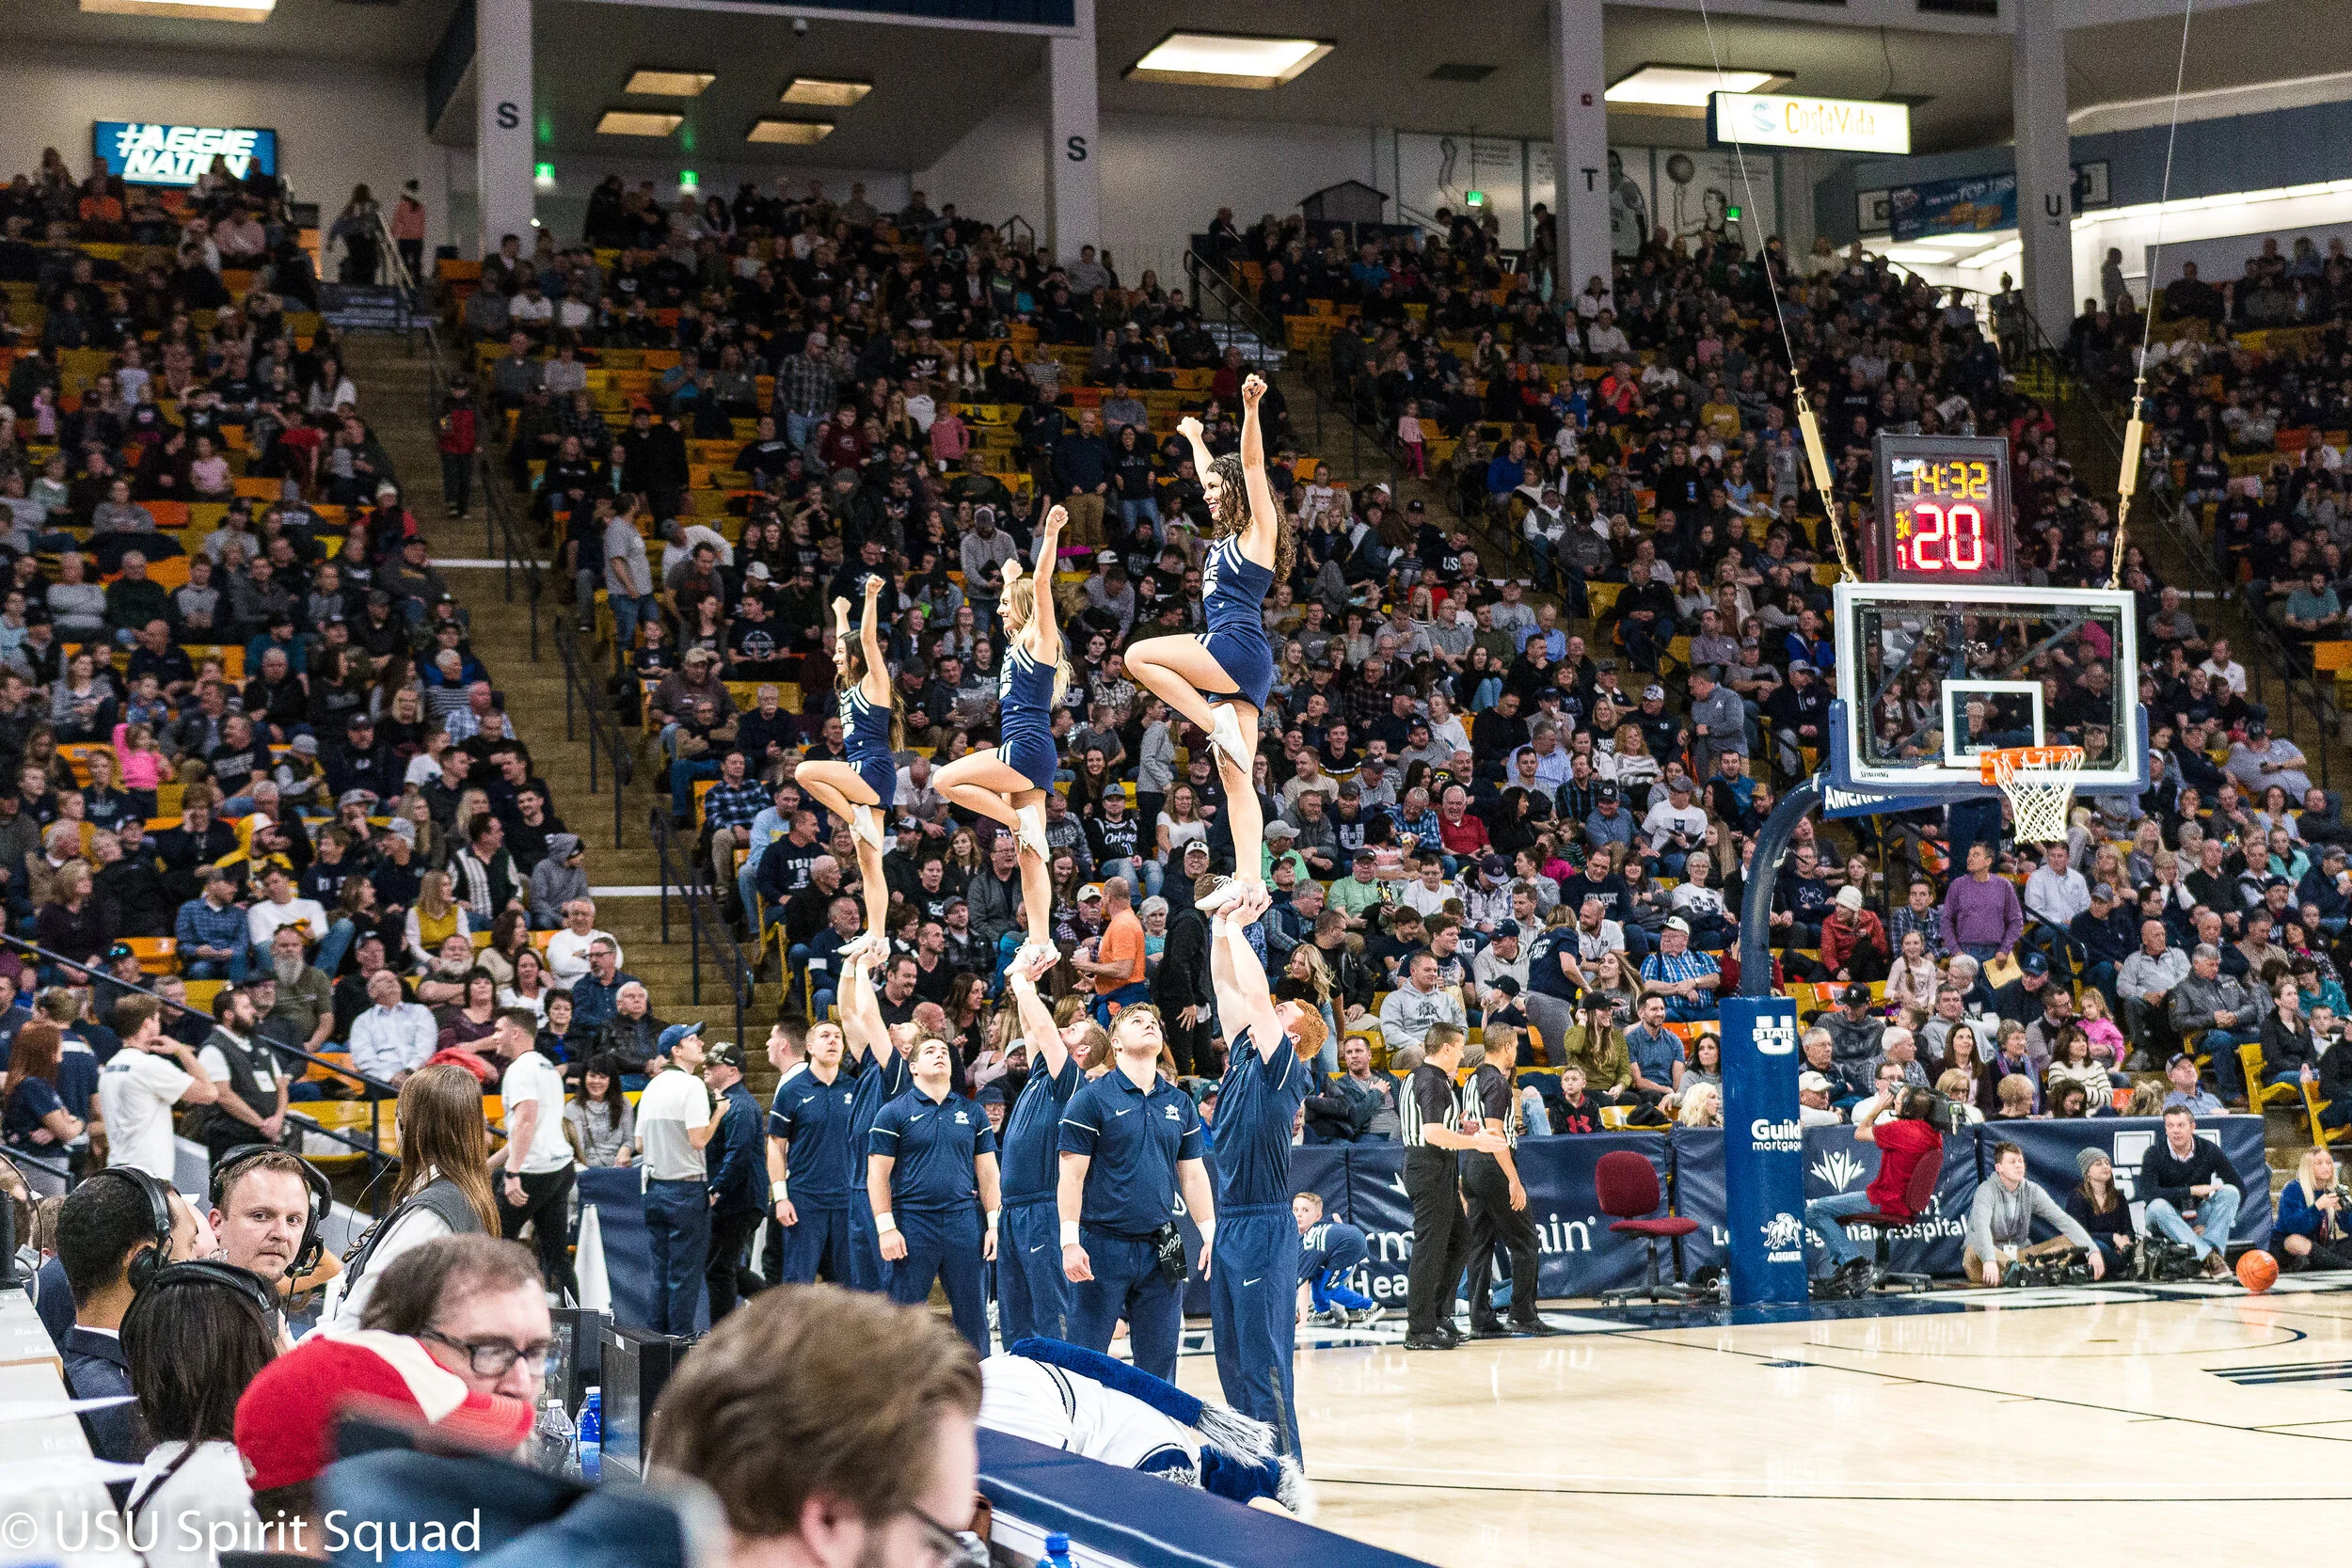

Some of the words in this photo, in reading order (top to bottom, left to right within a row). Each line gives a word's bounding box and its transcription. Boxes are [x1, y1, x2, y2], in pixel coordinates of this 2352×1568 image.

[497, 102, 519, 130] S
[116, 123, 259, 159] #AGGIE
[1067, 135, 1088, 162] S
[122, 149, 251, 181] NATIN
[1581, 167, 1598, 192] T
[2044, 194, 2062, 217] U
[1913, 461, 1988, 499] 14:32
[1913, 503, 1985, 570] 20
[1442, 556, 1462, 571] US
[1752, 1027, 1795, 1041] STATE
[1751, 1118, 1802, 1140] Guild
